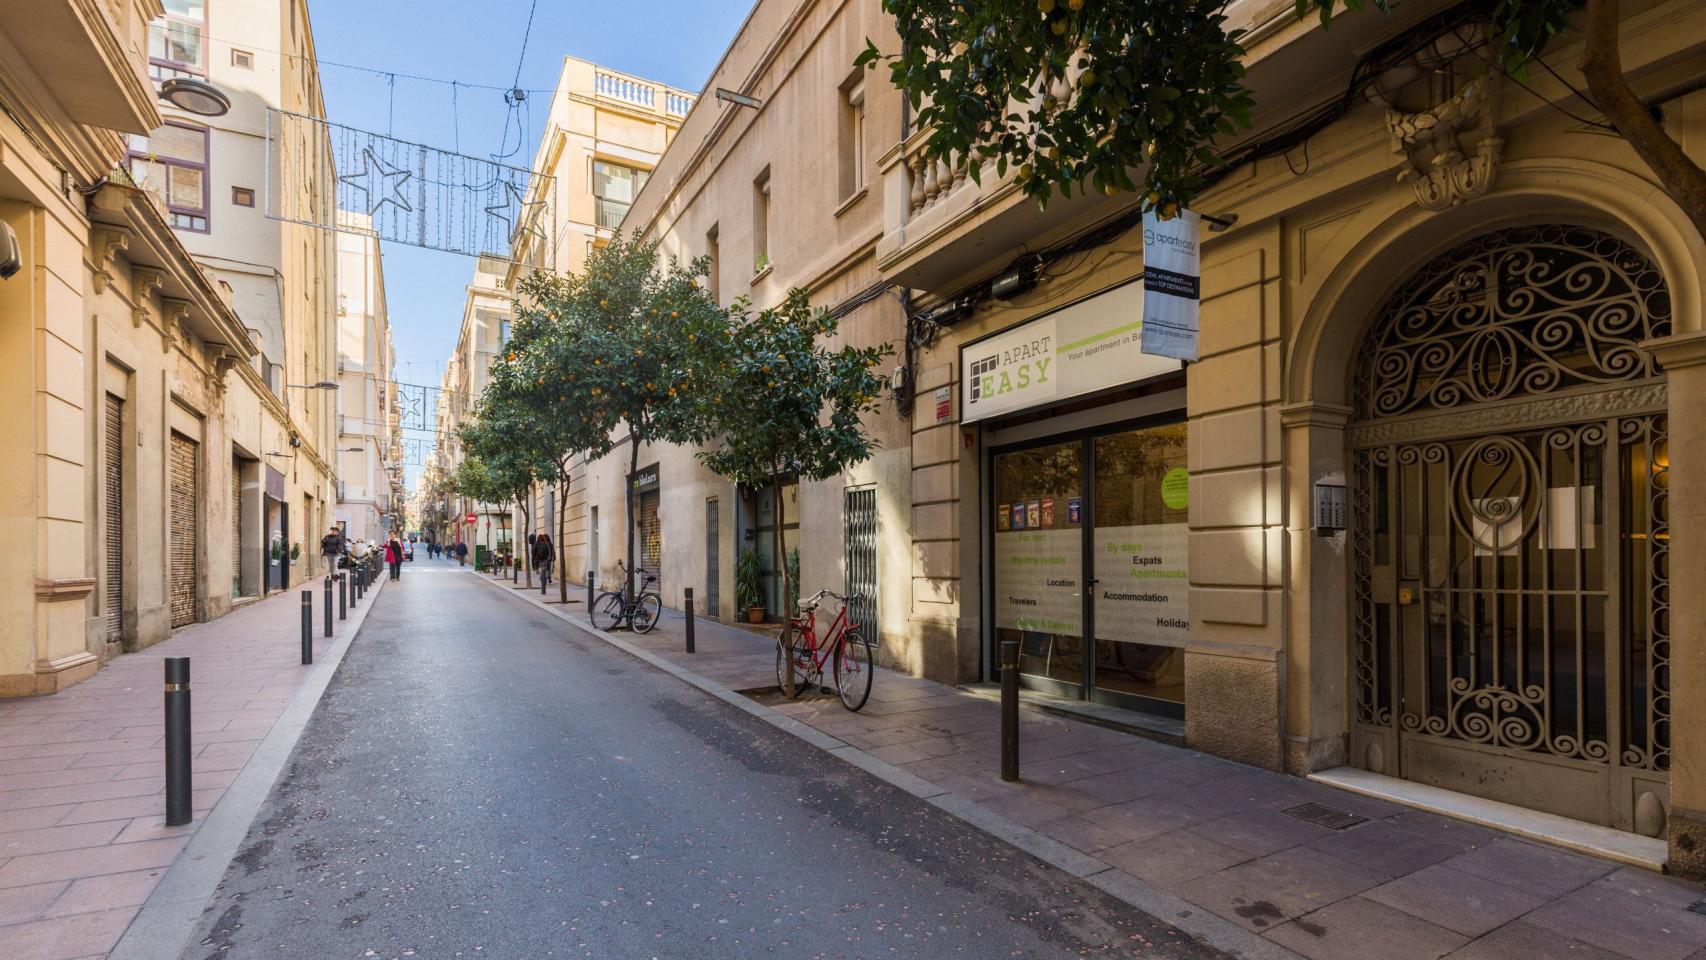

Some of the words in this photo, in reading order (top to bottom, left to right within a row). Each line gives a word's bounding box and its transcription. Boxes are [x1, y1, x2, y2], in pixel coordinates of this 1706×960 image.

[1156, 233, 1196, 252] aparteasy
[1003, 336, 1051, 366] APART
[1067, 349, 1084, 361] Your
[1084, 339, 1121, 357] apartment
[1122, 335, 1131, 345] in
[981, 357, 1052, 399] EASY
[1107, 543, 1119, 553] By
[1120, 543, 1143, 553] days
[1132, 555, 1162, 567] Expats
[1046, 578, 1076, 588] Location
[1008, 596, 1037, 606] Travelers
[1103, 592, 1169, 603] Accommodation
